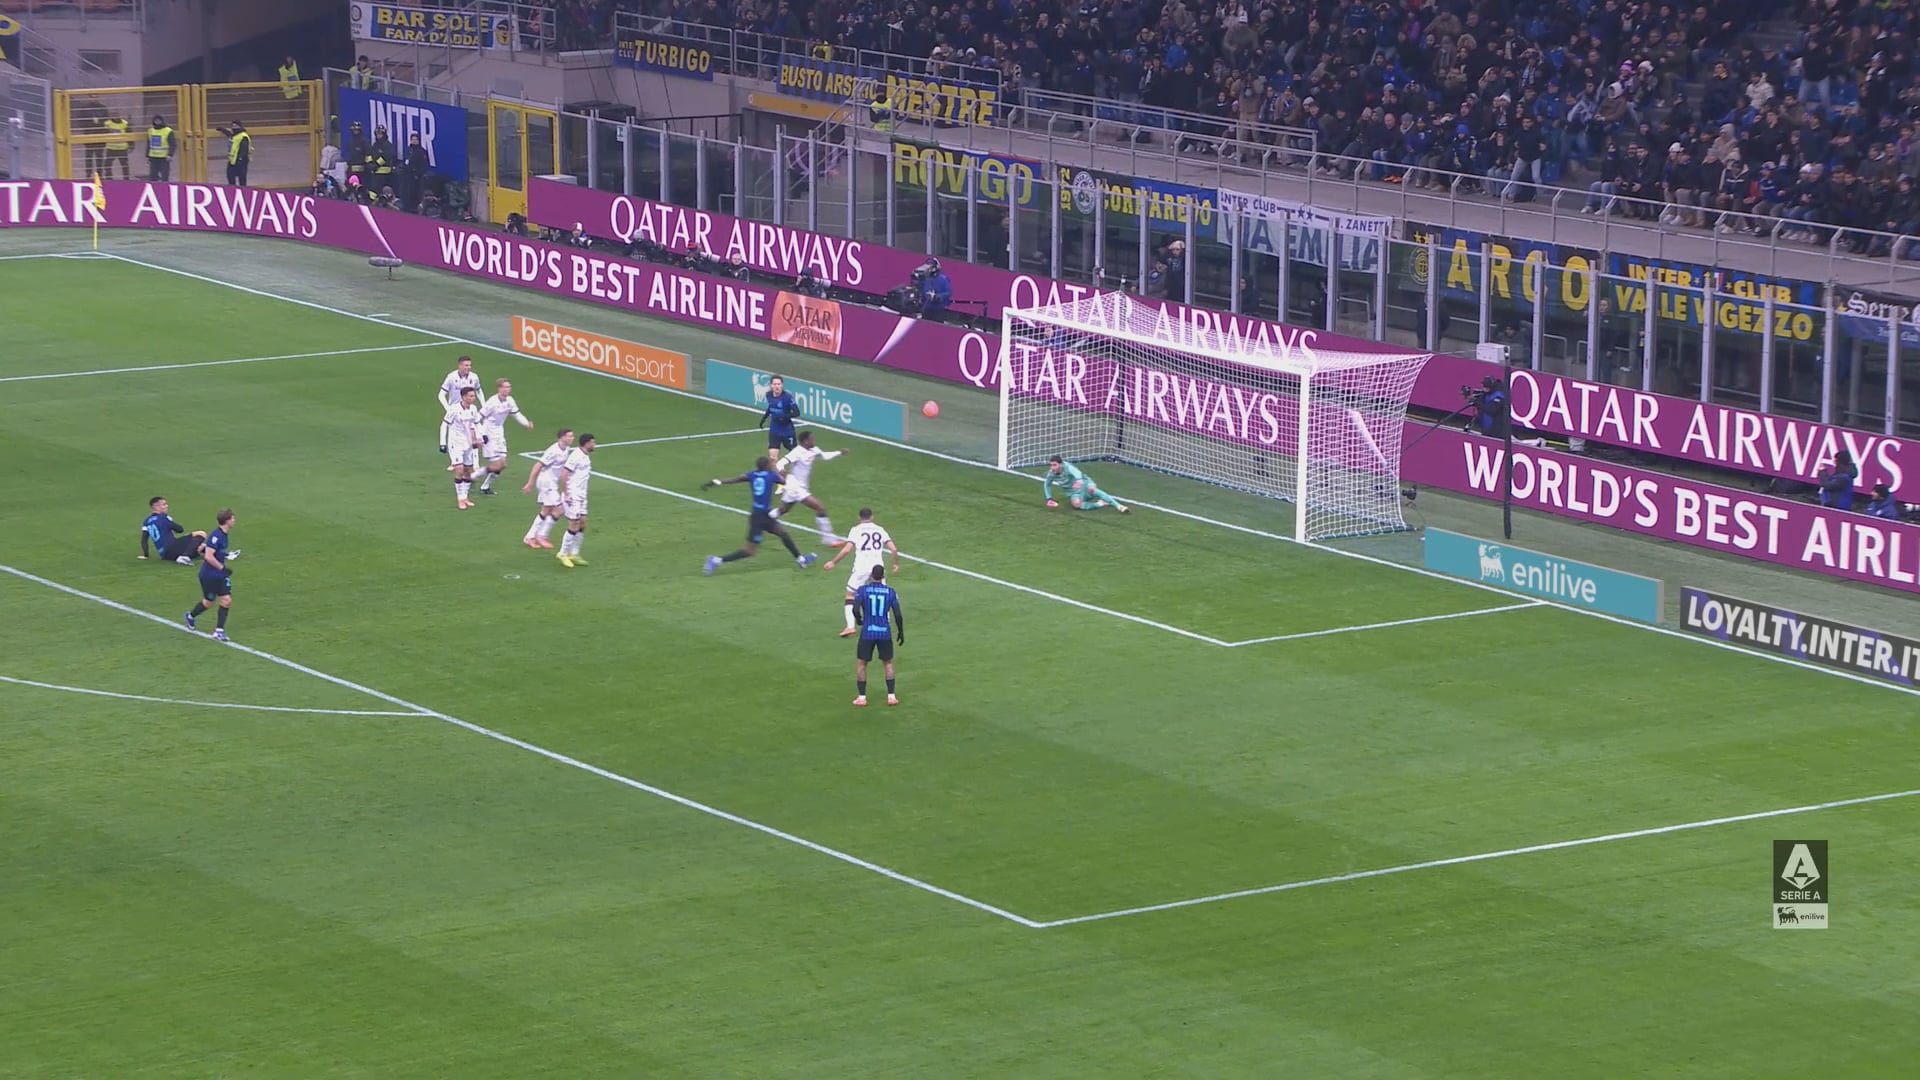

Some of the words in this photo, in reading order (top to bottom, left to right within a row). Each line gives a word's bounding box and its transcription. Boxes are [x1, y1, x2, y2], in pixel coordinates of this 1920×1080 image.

[377, 8, 426, 28] BAR
[433, 13, 489, 33] SOLE
[386, 28, 424, 41] FARA
[635, 39, 710, 73] TURBIGO
[780, 64, 822, 91] BUSTO
[886, 74, 996, 127] MESTRE
[369, 99, 437, 167] INTER
[0, 181, 108, 223] TAR
[130, 182, 318, 239] AIRWAYS
[1100, 184, 1212, 226] CORAREO
[1220, 191, 1249, 209] INTER
[1253, 197, 1276, 213] CLUB
[610, 196, 713, 257] QATAR
[726, 218, 863, 286] AIRWAYS
[1288, 219, 1380, 271] EMLIA
[438, 227, 562, 289] WORLD'S
[571, 255, 640, 304] BEST
[648, 271, 766, 331] AIRLINE
[1628, 263, 1692, 288] INTER
[1733, 280, 1792, 304] CLUB
[782, 302, 831, 331] QATAR
[1615, 285, 1688, 321] VALE
[792, 327, 831, 345] AIRWAYS
[1010, 275, 1134, 336] QATAR
[1153, 302, 1318, 373] AIRWAYS
[521, 317, 676, 384] betsson.sport
[785, 387, 853, 424] nilive
[958, 332, 1088, 404] QATAR
[1104, 362, 1279, 445] AIRWAYS
[1510, 370, 1662, 449] QATAR
[1681, 403, 1903, 493] AIRWAYS
[752, 477, 766, 496] 9
[1463, 441, 1659, 527] WORLD'S
[1673, 486, 1789, 555] BEST
[1801, 516, 1920, 586] AIRL
[860, 532, 883, 551] 28
[1512, 560, 1597, 603] enilive
[868, 594, 885, 617] 11
